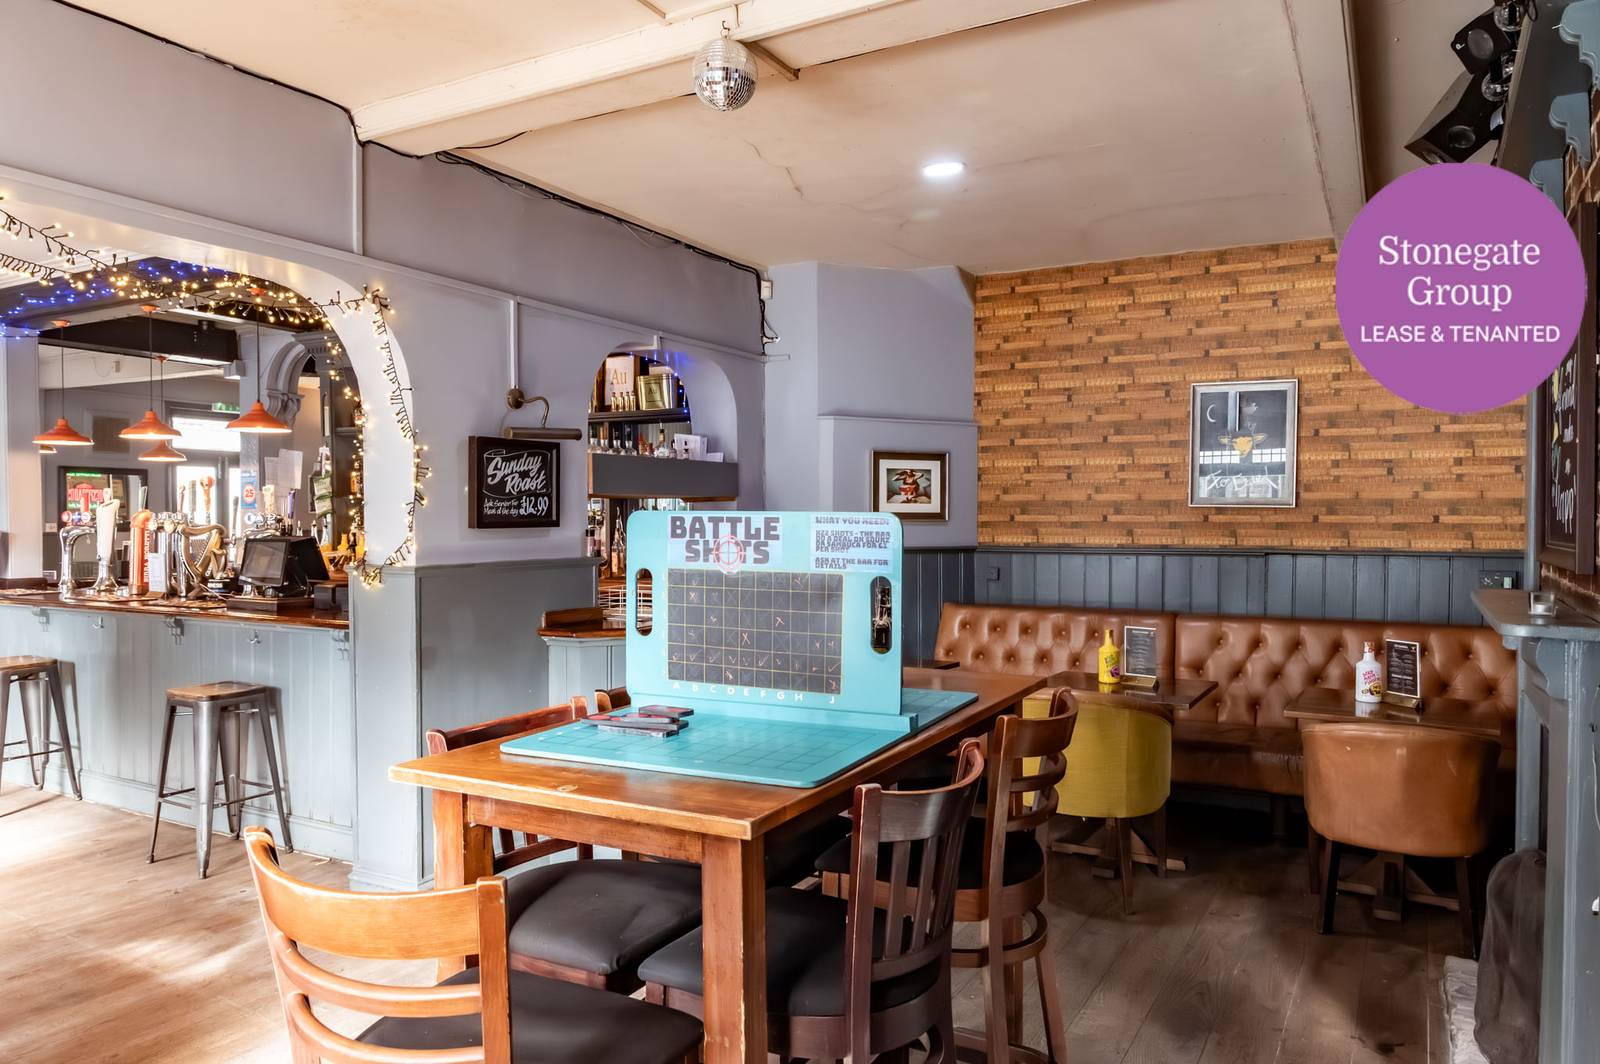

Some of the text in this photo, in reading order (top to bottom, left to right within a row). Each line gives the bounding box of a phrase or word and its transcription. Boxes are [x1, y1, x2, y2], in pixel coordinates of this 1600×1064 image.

[611, 367, 627, 385] Au
[487, 452, 542, 485] Sunday
[244, 488, 254, 498] 25
[504, 470, 547, 495] Roast
[670, 516, 780, 541] BATTLE
[815, 516, 840, 525] WHAT
[842, 517, 860, 525] YOU
[685, 539, 770, 565] SHOTS
[672, 682, 681, 690] A
[709, 685, 717, 693] C
[743, 688, 750, 696] E
[760, 690, 767, 698] F
[776, 691, 785, 700] G
[794, 693, 804, 702] H
[829, 695, 835, 704] J
